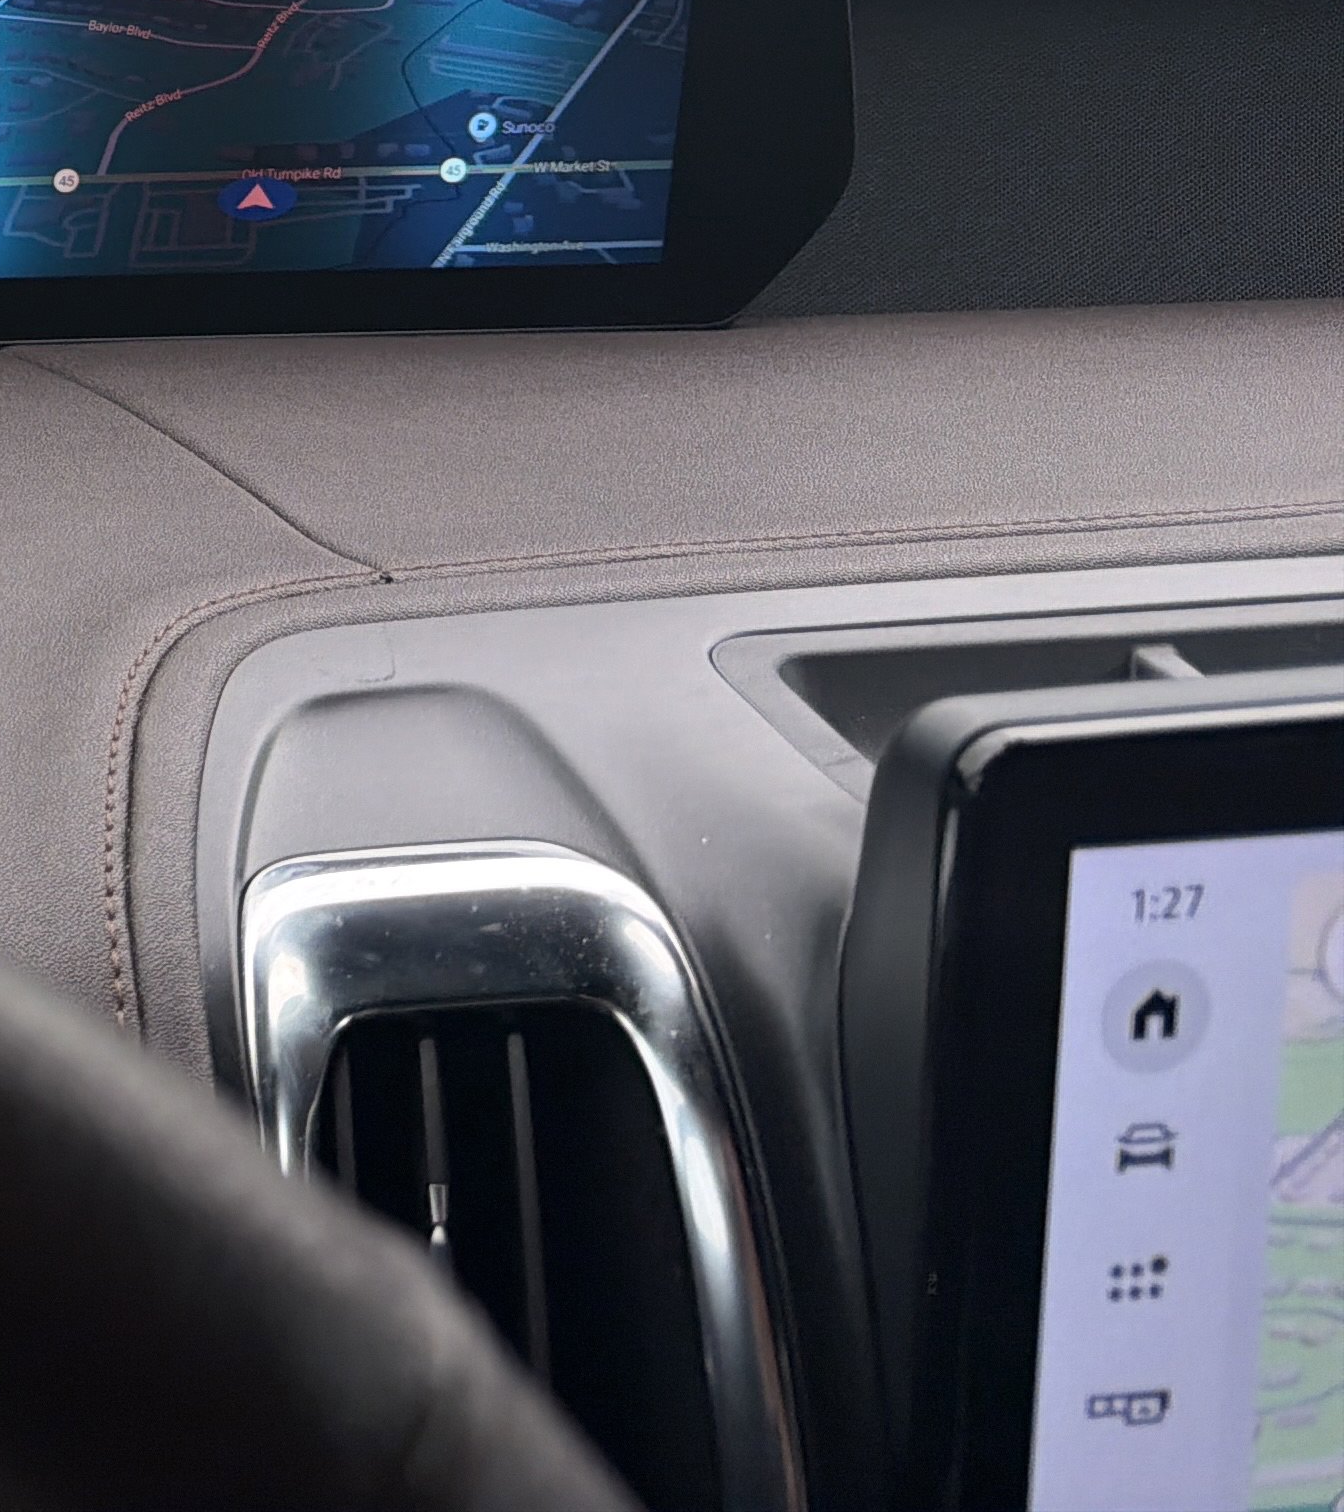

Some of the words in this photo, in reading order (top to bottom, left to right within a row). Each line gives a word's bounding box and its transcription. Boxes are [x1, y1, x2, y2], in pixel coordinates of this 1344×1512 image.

[88, 19, 124, 35] Baylor
[126, 24, 152, 39] Blvd
[257, 23, 280, 49] Reitz
[276, 2, 300, 24] Blvd
[125, 100, 155, 121] Reitz
[155, 89, 181, 106] Blvd
[502, 120, 555, 135] Sunoco
[241, 168, 265, 179] Old
[323, 166, 342, 180] Rd
[445, 164, 462, 177] 45
[534, 161, 548, 174] W
[550, 160, 594, 174] Market
[596, 160, 611, 172] St
[58, 175, 75, 188] 45
[444, 195, 493, 255] Fairground
[486, 240, 559, 254] Washington
[561, 239, 584, 252] Ave
[1131, 883, 1205, 923] 1:27
